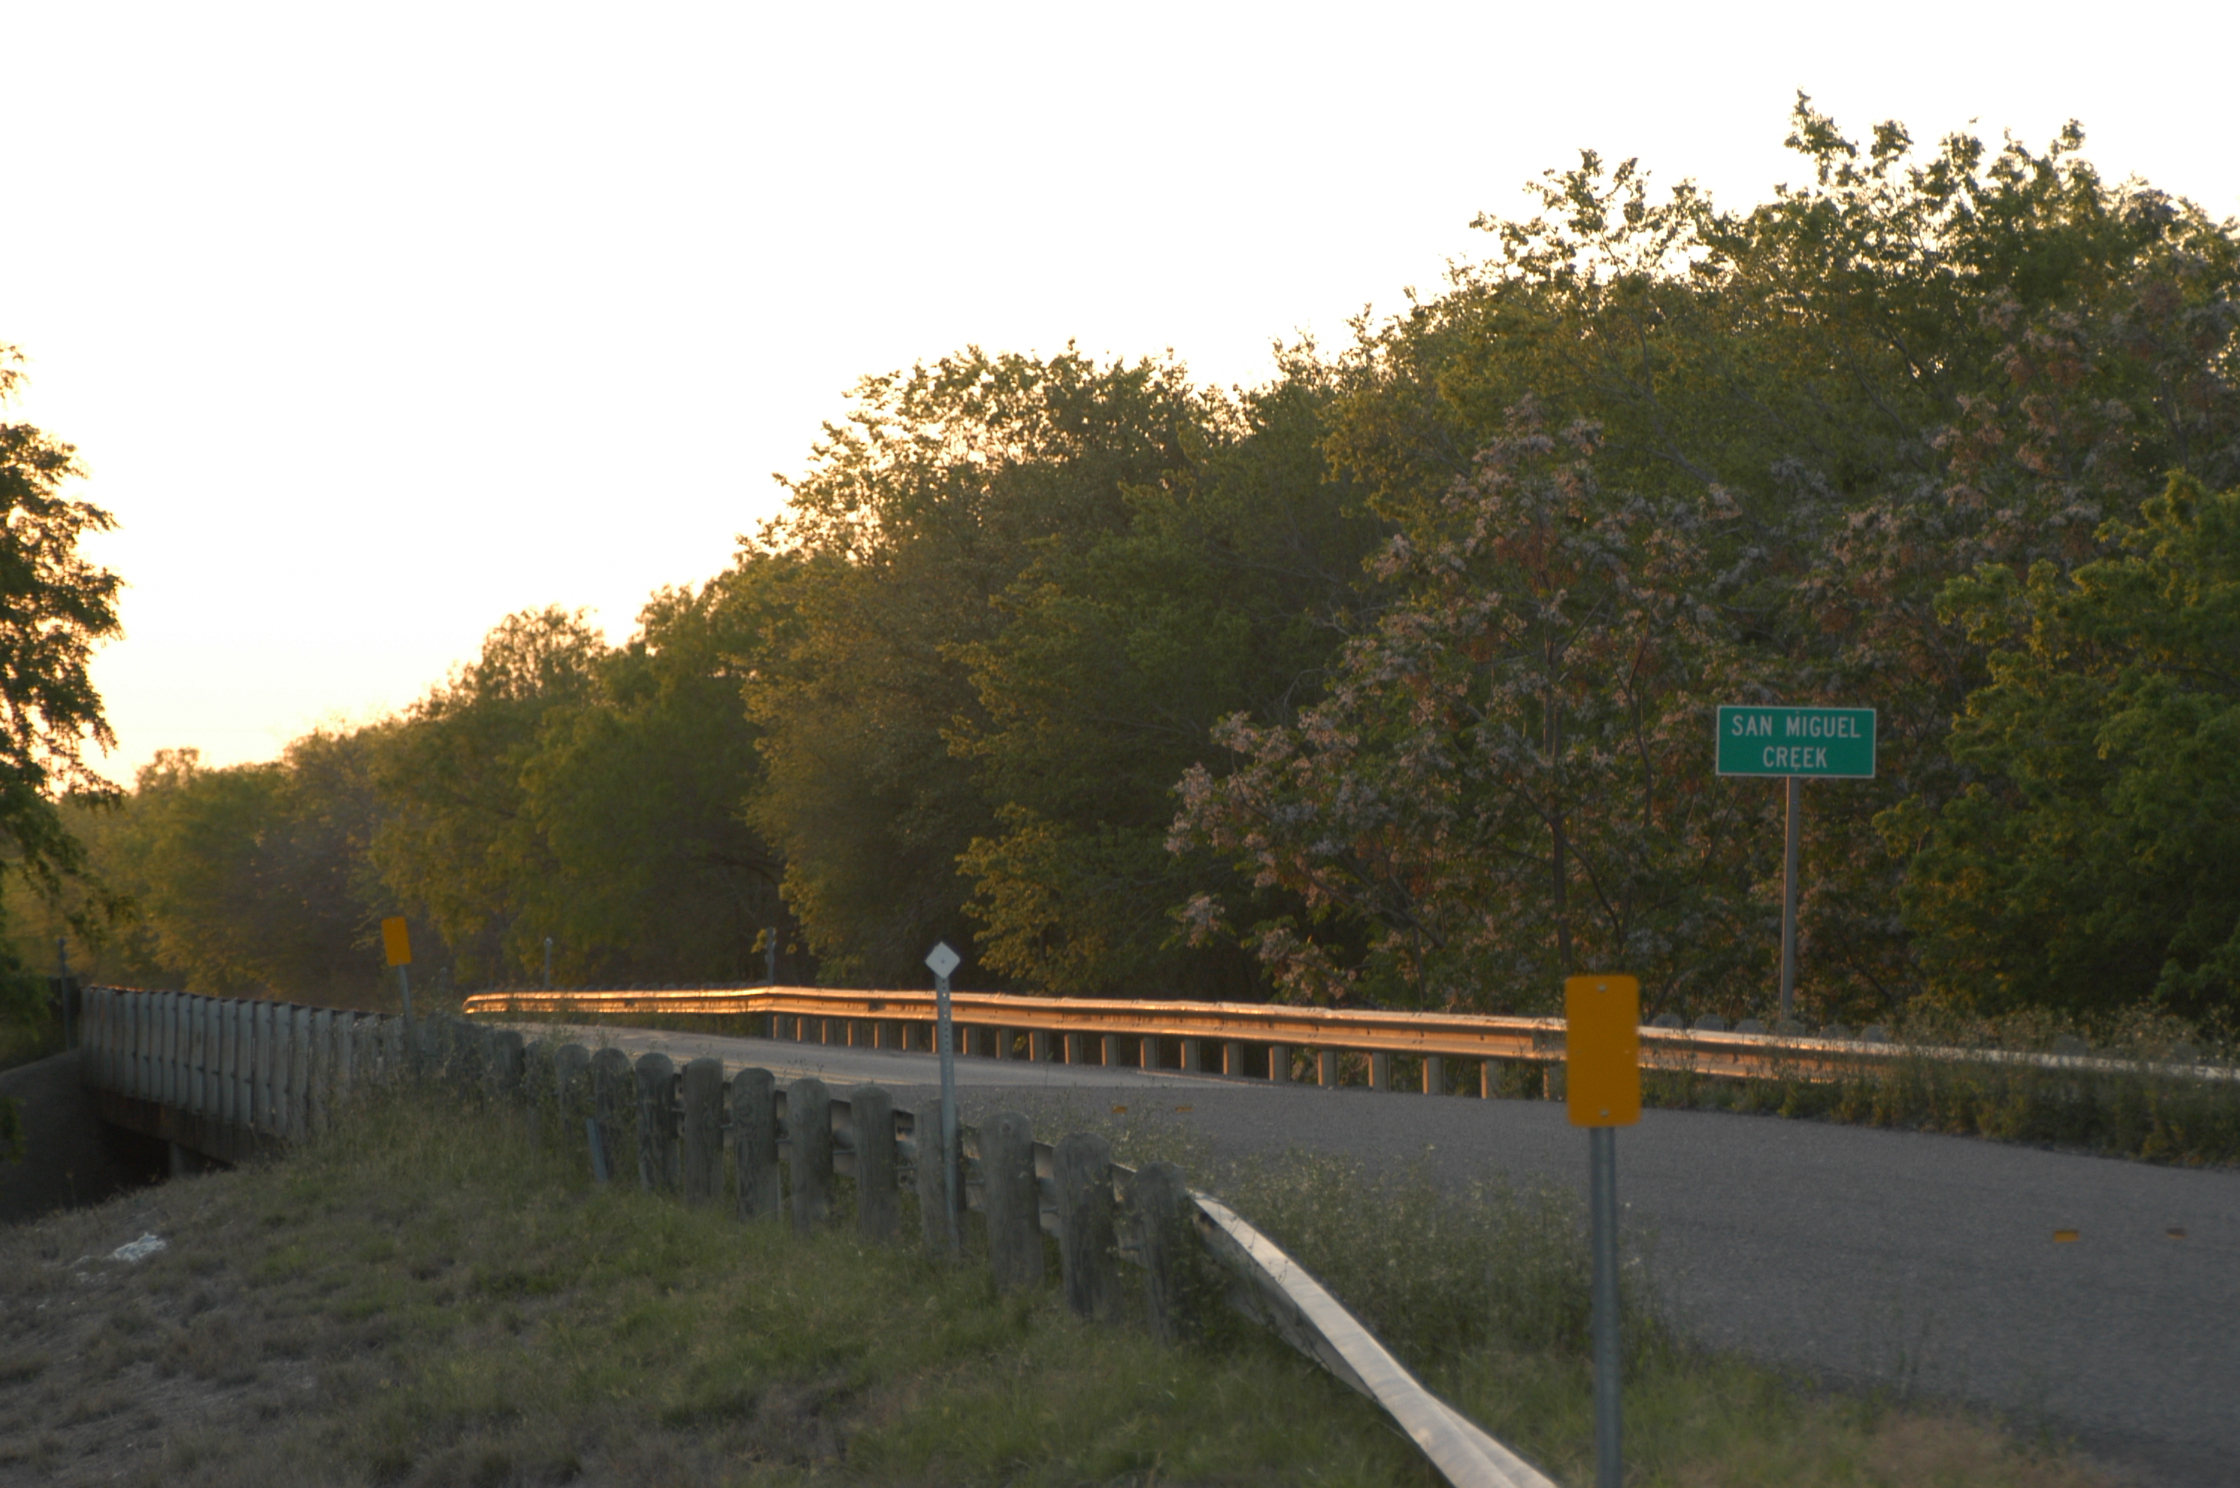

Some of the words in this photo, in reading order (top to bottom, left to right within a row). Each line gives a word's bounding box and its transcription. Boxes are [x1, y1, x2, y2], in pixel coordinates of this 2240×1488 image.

[1731, 714, 1773, 737] SAN
[1786, 715, 1861, 738] MIGUEL
[1762, 746, 1828, 768] CREEK
